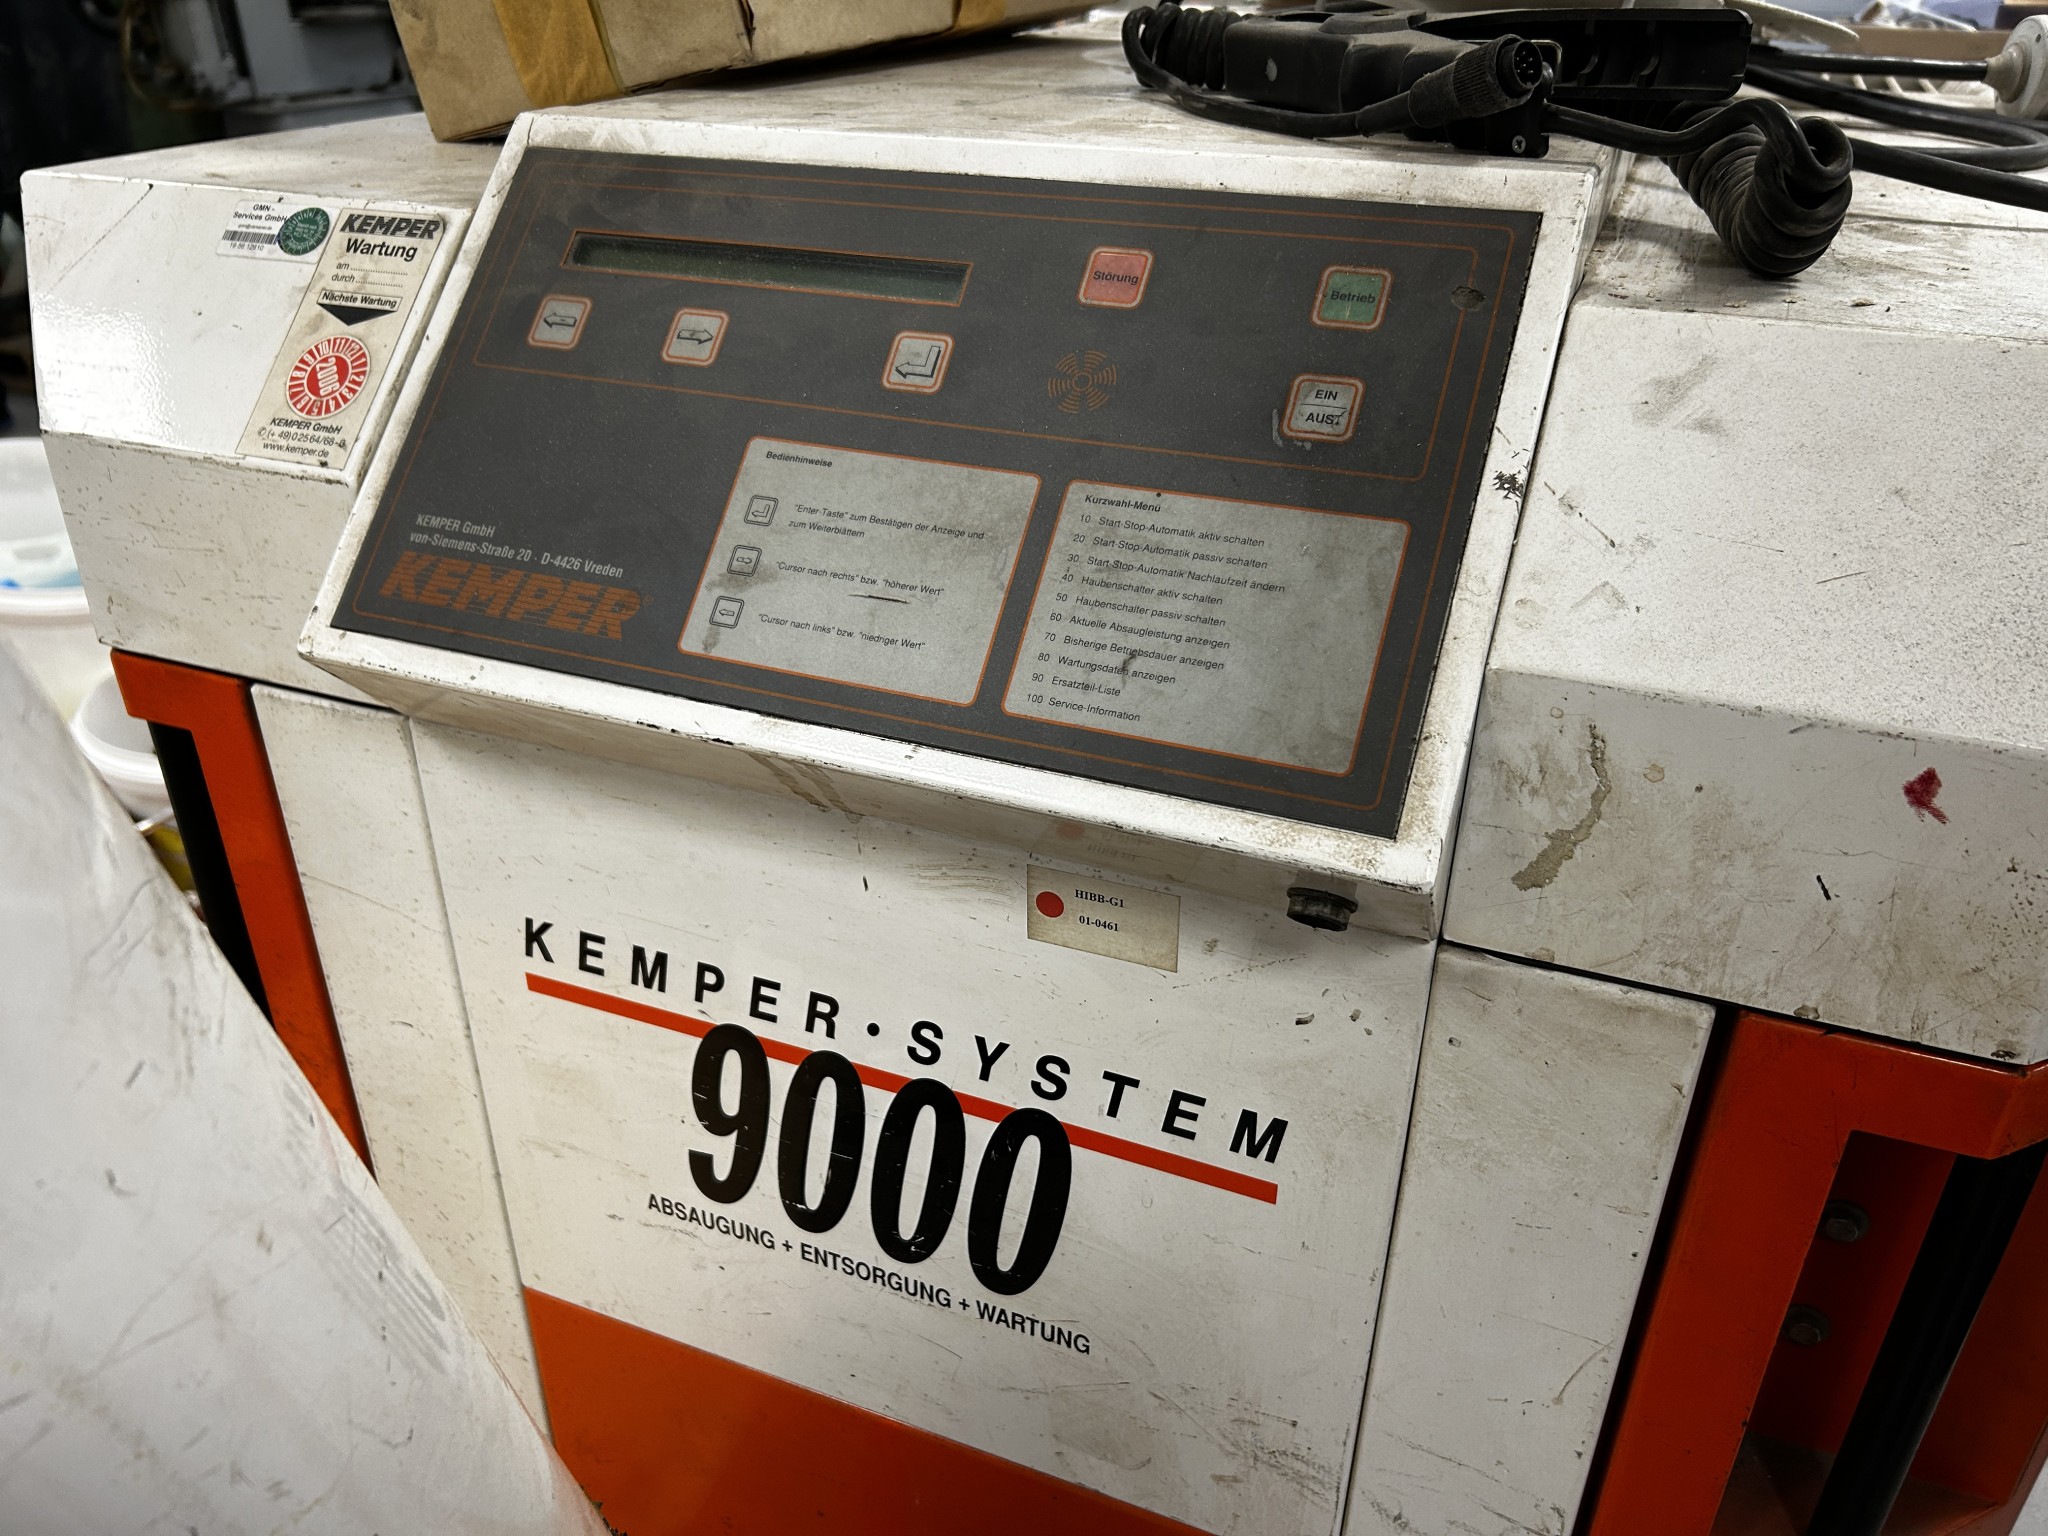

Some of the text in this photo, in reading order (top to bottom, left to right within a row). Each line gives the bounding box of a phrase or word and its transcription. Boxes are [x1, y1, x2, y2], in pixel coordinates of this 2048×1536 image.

[233, 212, 262, 220] Services
[340, 214, 440, 240] KEMPER
[346, 238, 418, 262] Wartung
[332, 273, 355, 283] durch
[1093, 270, 1139, 286] Störung
[322, 291, 397, 308] Nächste Wartung
[1330, 289, 1376, 305] Betrieb
[316, 357, 340, 396] 2006
[1314, 389, 1338, 401] EIN
[270, 418, 342, 434] KEMPER GmbH
[1305, 412, 1335, 425] AUS
[263, 442, 329, 458] www.kemper.de
[766, 451, 833, 468] Bedienhinweise
[1084, 495, 1161, 512] Kurzwahl-Menü
[416, 514, 496, 538] KEMPER GmbH
[788, 520, 865, 538] zum Weiterblättern
[849, 514, 867, 523] zum
[869, 515, 913, 530] Bestätigen
[914, 521, 929, 532] der
[930, 524, 965, 539] Anzeige
[967, 531, 985, 540] und
[1080, 514, 1265, 547] 10 Start-Stop-Automatik aktiv schalten
[410, 532, 515, 560] von-Siemens-Straße
[516, 548, 532, 562] 20
[541, 552, 583, 571] D-4426
[584, 559, 623, 578] Vreden
[1073, 534, 1268, 569] 20 Start-Stop-Automatik passiv schalten
[776, 561, 806, 573] "Cursor
[807, 567, 828, 577] nach
[830, 571, 860, 582] rechts"
[860, 576, 879, 586] bzw.
[920, 585, 944, 596] Wert"
[1067, 553, 1285, 593] 30 Start-Stop-Automatik Nachlaufzeit ändern
[379, 551, 642, 641] KEMPER
[1061, 574, 1223, 605] 40 Haubenschalter aktiv schalten
[1055, 592, 1226, 627] 50 Haubenschalter passiv schalten
[758, 613, 788, 626] "Cursor
[790, 620, 811, 630] nach
[812, 623, 835, 634] links"
[836, 628, 855, 638] bzw.
[900, 638, 926, 650] Wert"
[1050, 612, 1230, 650] 60 Aktuelle Absaugleistung anzeigen
[1044, 632, 1224, 671] 70 Bisherige Betriebsdauer anzeigen
[1037, 652, 1176, 684] 80 Wartungsdaten anzeigen
[1032, 673, 1121, 697] 90 Ersatzteil-Liste
[1027, 694, 1140, 722] 100 Service-Information
[1074, 889, 1124, 908] HIBB-G1
[1079, 915, 1119, 932] 01-0461
[688, 1023, 1073, 1296] 9000
[647, 1192, 776, 1250] ABSAUGUNG
[800, 1242, 952, 1311] ENTSORGUNG
[976, 1301, 1091, 1356] WARTUNG
